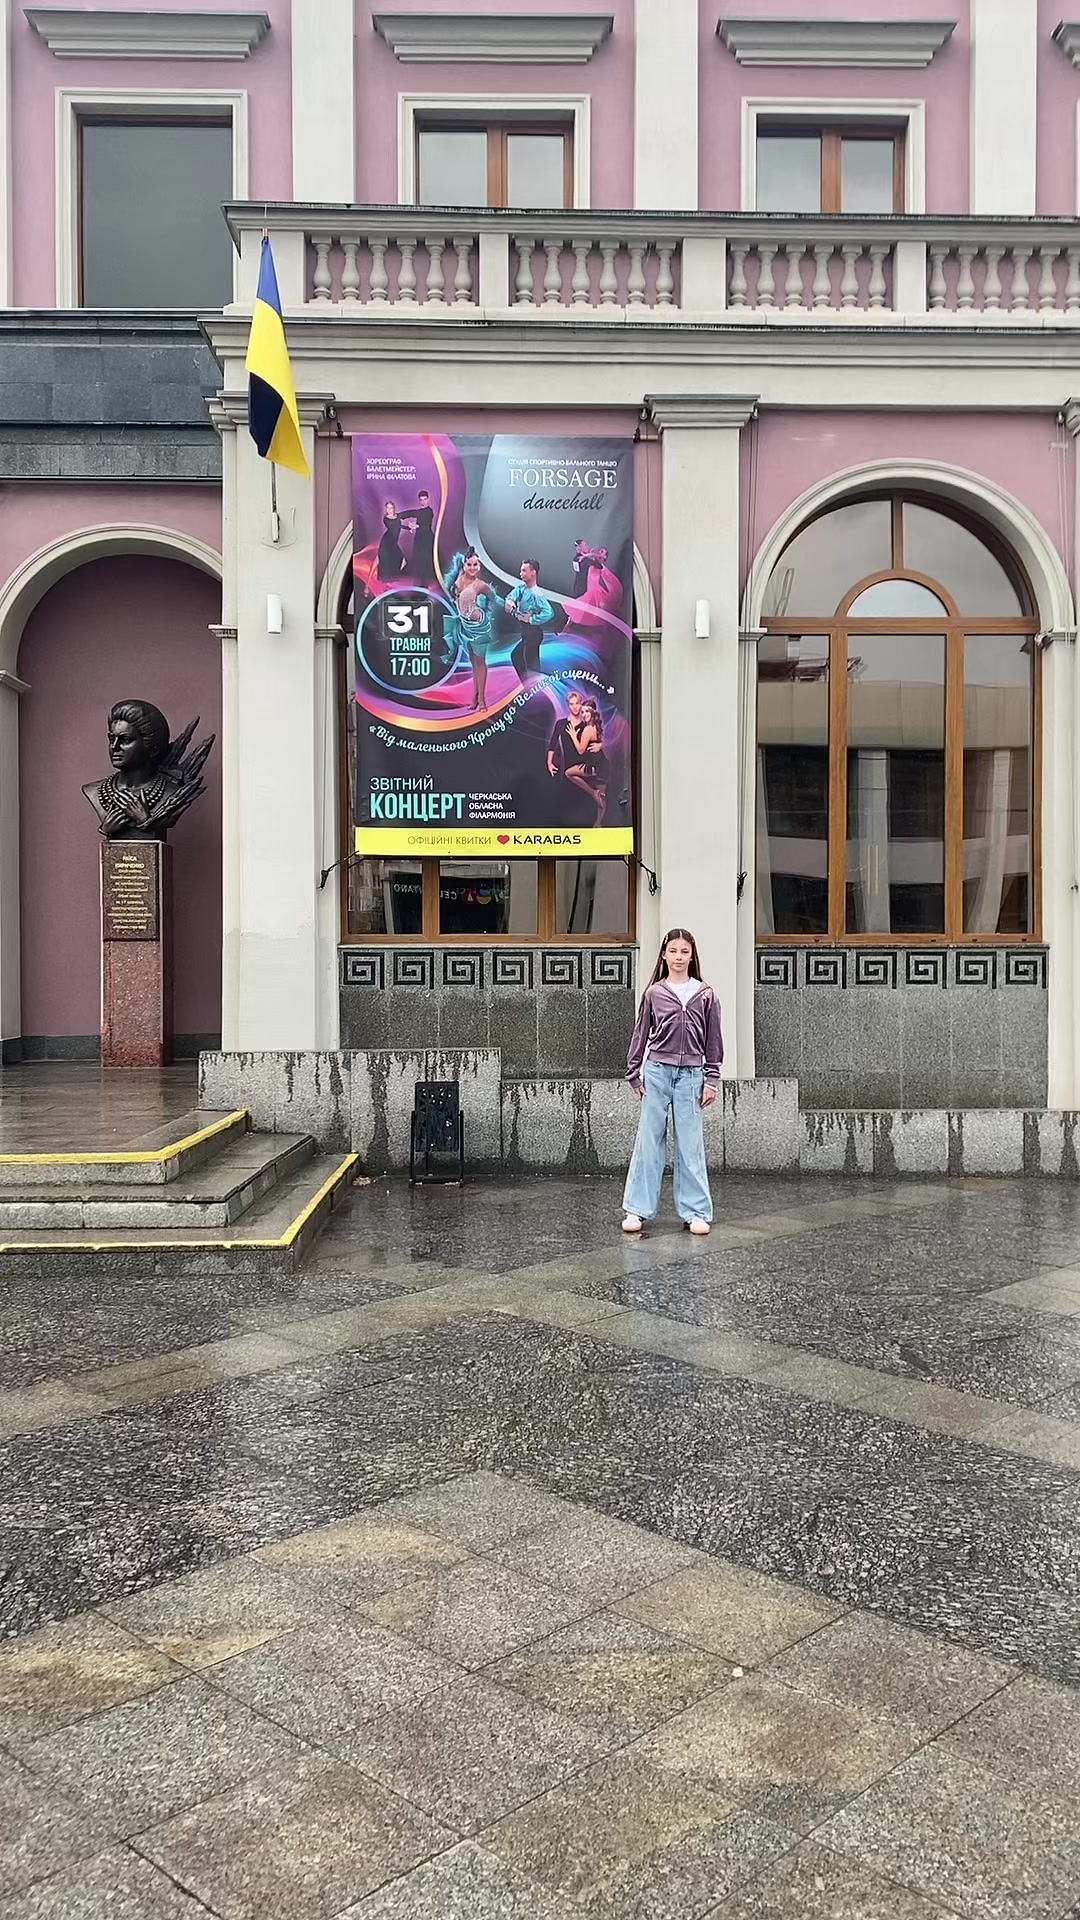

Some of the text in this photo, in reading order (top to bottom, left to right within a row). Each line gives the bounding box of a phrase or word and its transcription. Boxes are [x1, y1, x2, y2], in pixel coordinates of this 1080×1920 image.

[508, 468, 618, 489] FORSAGE
[523, 490, 604, 511] dancehall
[387, 606, 428, 633] 31
[389, 637, 430, 651] ТРАВНЯ
[390, 657, 430, 676] 17:00
[396, 739, 469, 752] маленького
[468, 719, 506, 746] Кроку
[503, 706, 516, 724] до
[513, 670, 561, 706] Великої
[370, 774, 433, 790] ЗВІТНИЙ
[468, 792, 513, 800] ЧЕРКАСЬКА
[370, 793, 466, 821] КОНЦЕРТ
[468, 802, 504, 810] ОБЛАСНА
[468, 811, 516, 819] ФІЛАРМОНІЯ
[407, 834, 582, 845] ОФІЦІЙНІ КВИТКИ KARABAS
